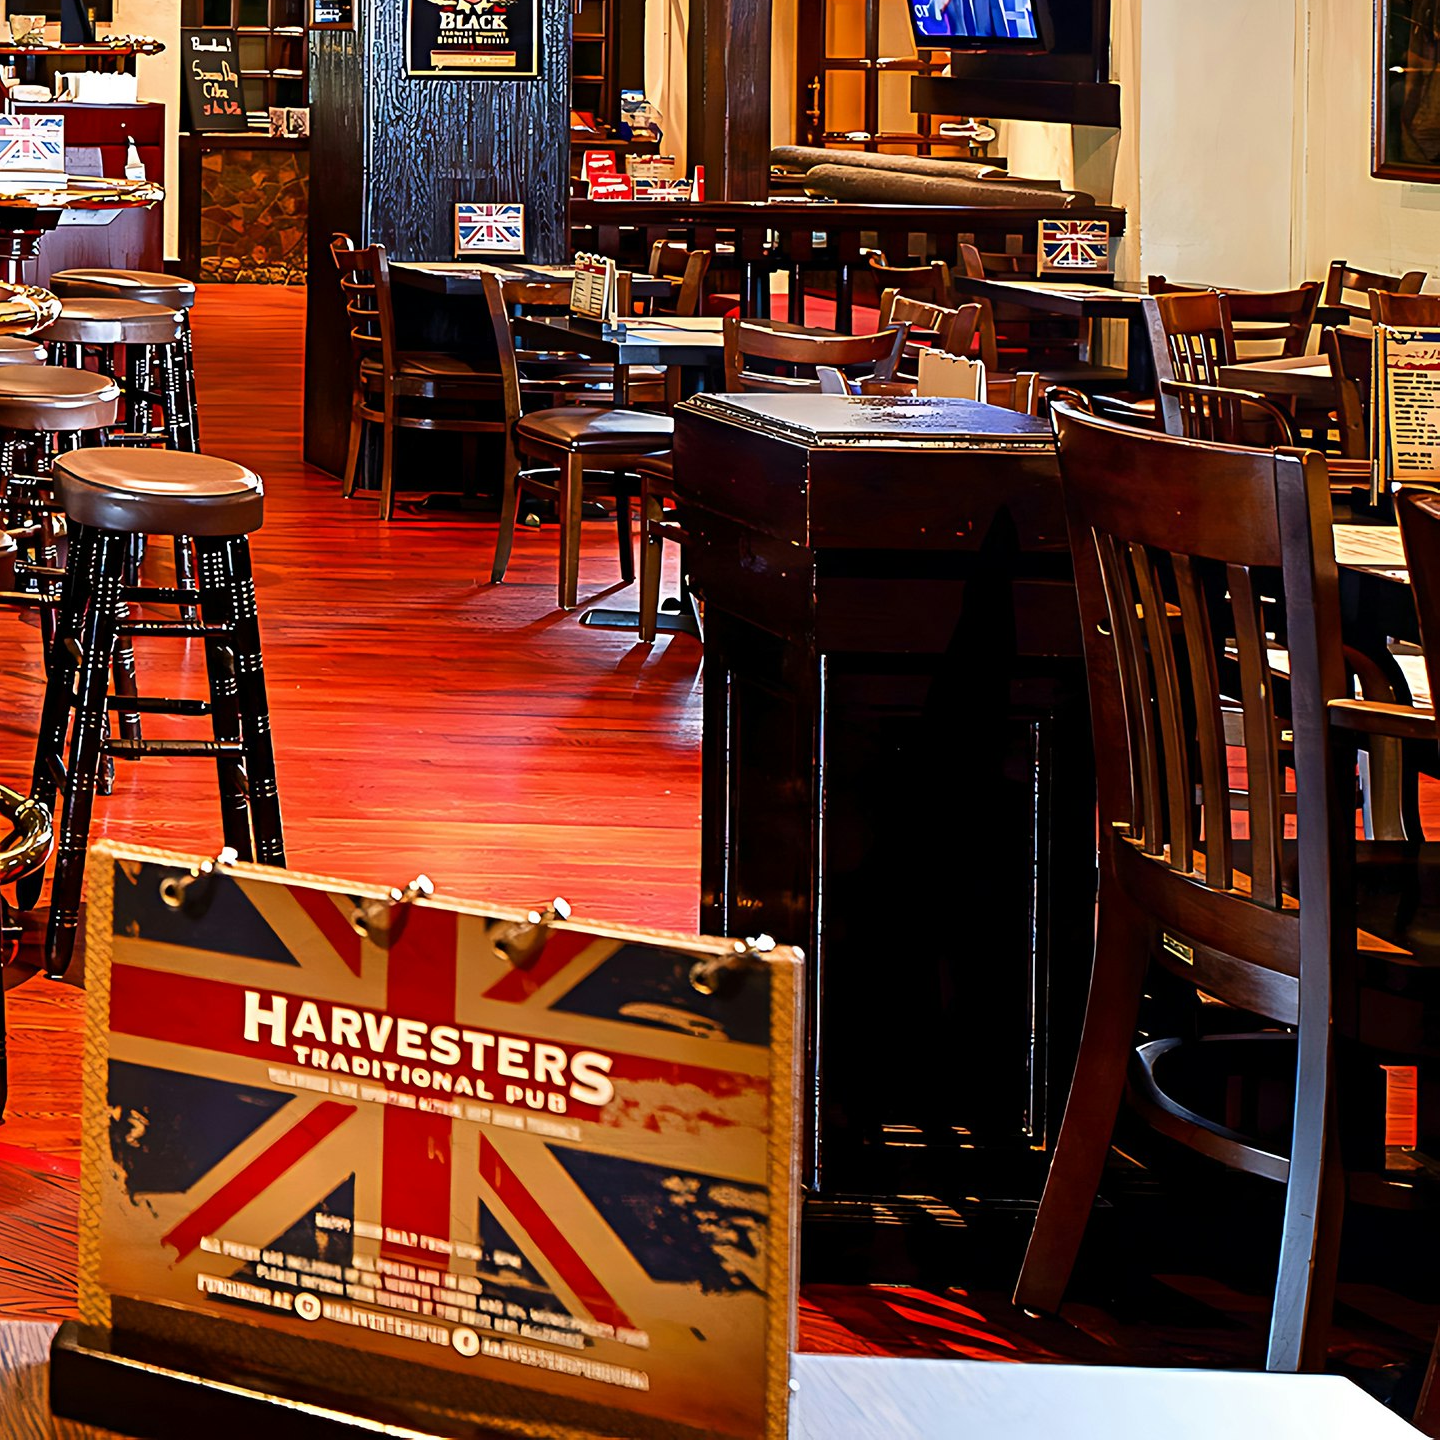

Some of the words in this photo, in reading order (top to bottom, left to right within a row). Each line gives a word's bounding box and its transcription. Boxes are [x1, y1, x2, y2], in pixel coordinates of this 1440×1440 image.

[439, 11, 508, 30] BLACK
[243, 990, 616, 1107] HARVESTERS
[292, 1043, 495, 1101] TRADITIONAL
[504, 1084, 567, 1114] PUB
